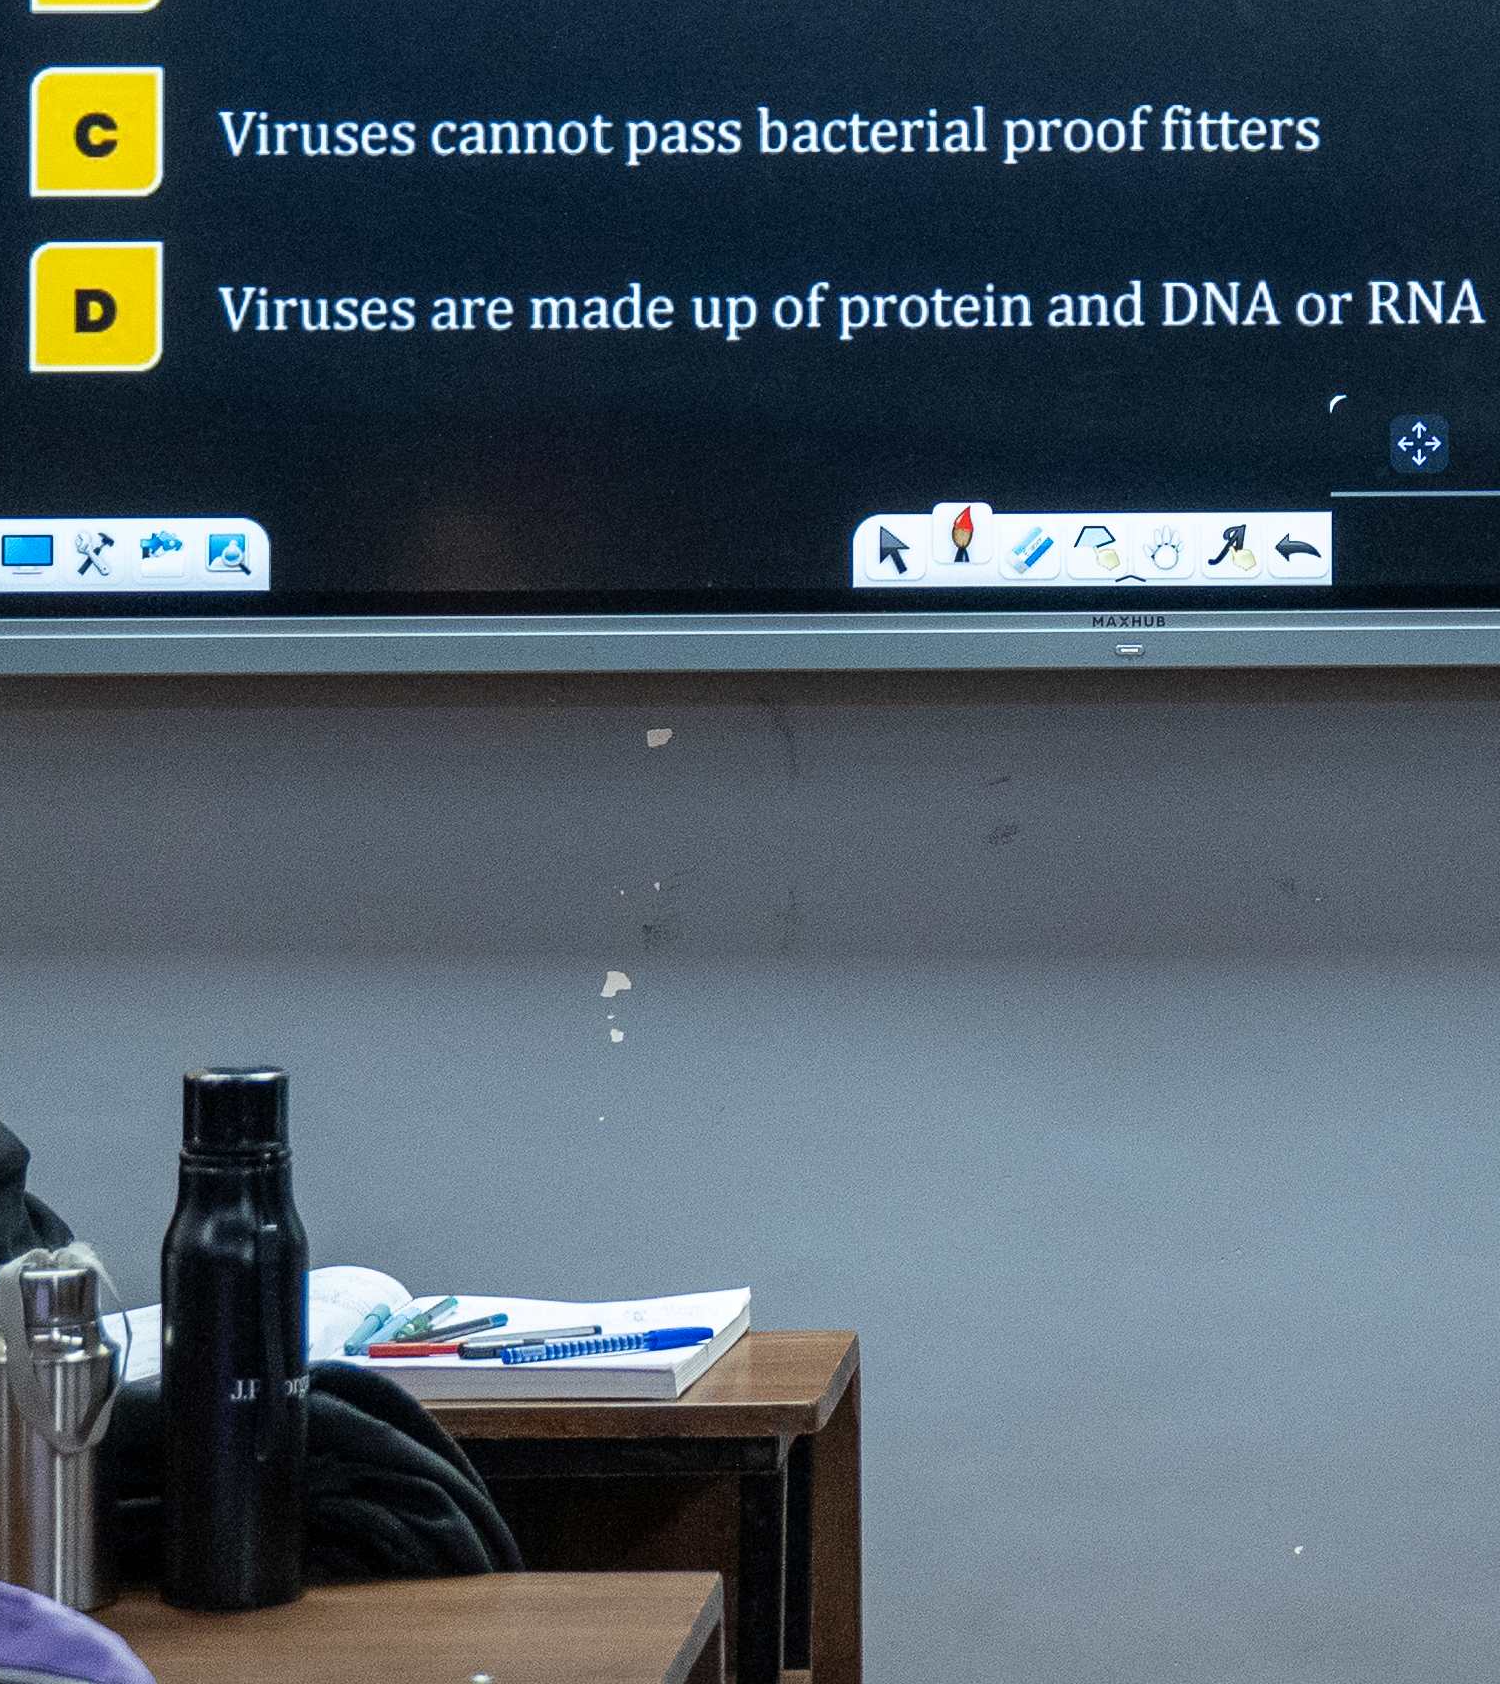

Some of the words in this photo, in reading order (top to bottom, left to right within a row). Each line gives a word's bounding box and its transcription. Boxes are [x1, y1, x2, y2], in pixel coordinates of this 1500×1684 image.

[74, 113, 117, 157] C
[218, 111, 416, 157] Viruses
[431, 114, 614, 157] cannot
[626, 119, 742, 167] pass
[757, 105, 988, 154] bacterial
[1003, 104, 1153, 165] proof
[1161, 104, 1320, 152] fitters
[75, 289, 117, 333] D
[218, 286, 416, 332] Viruses
[431, 296, 514, 331] are
[530, 282, 675, 331] made
[691, 295, 758, 342] up
[772, 281, 830, 330] of
[839, 282, 1033, 341] protein
[1047, 279, 1145, 328] and
[1162, 280, 1281, 327] DNA
[1295, 292, 1353, 327] or
[1368, 278, 1486, 325] RNA
[1092, 615, 1166, 628] MAXHUB
